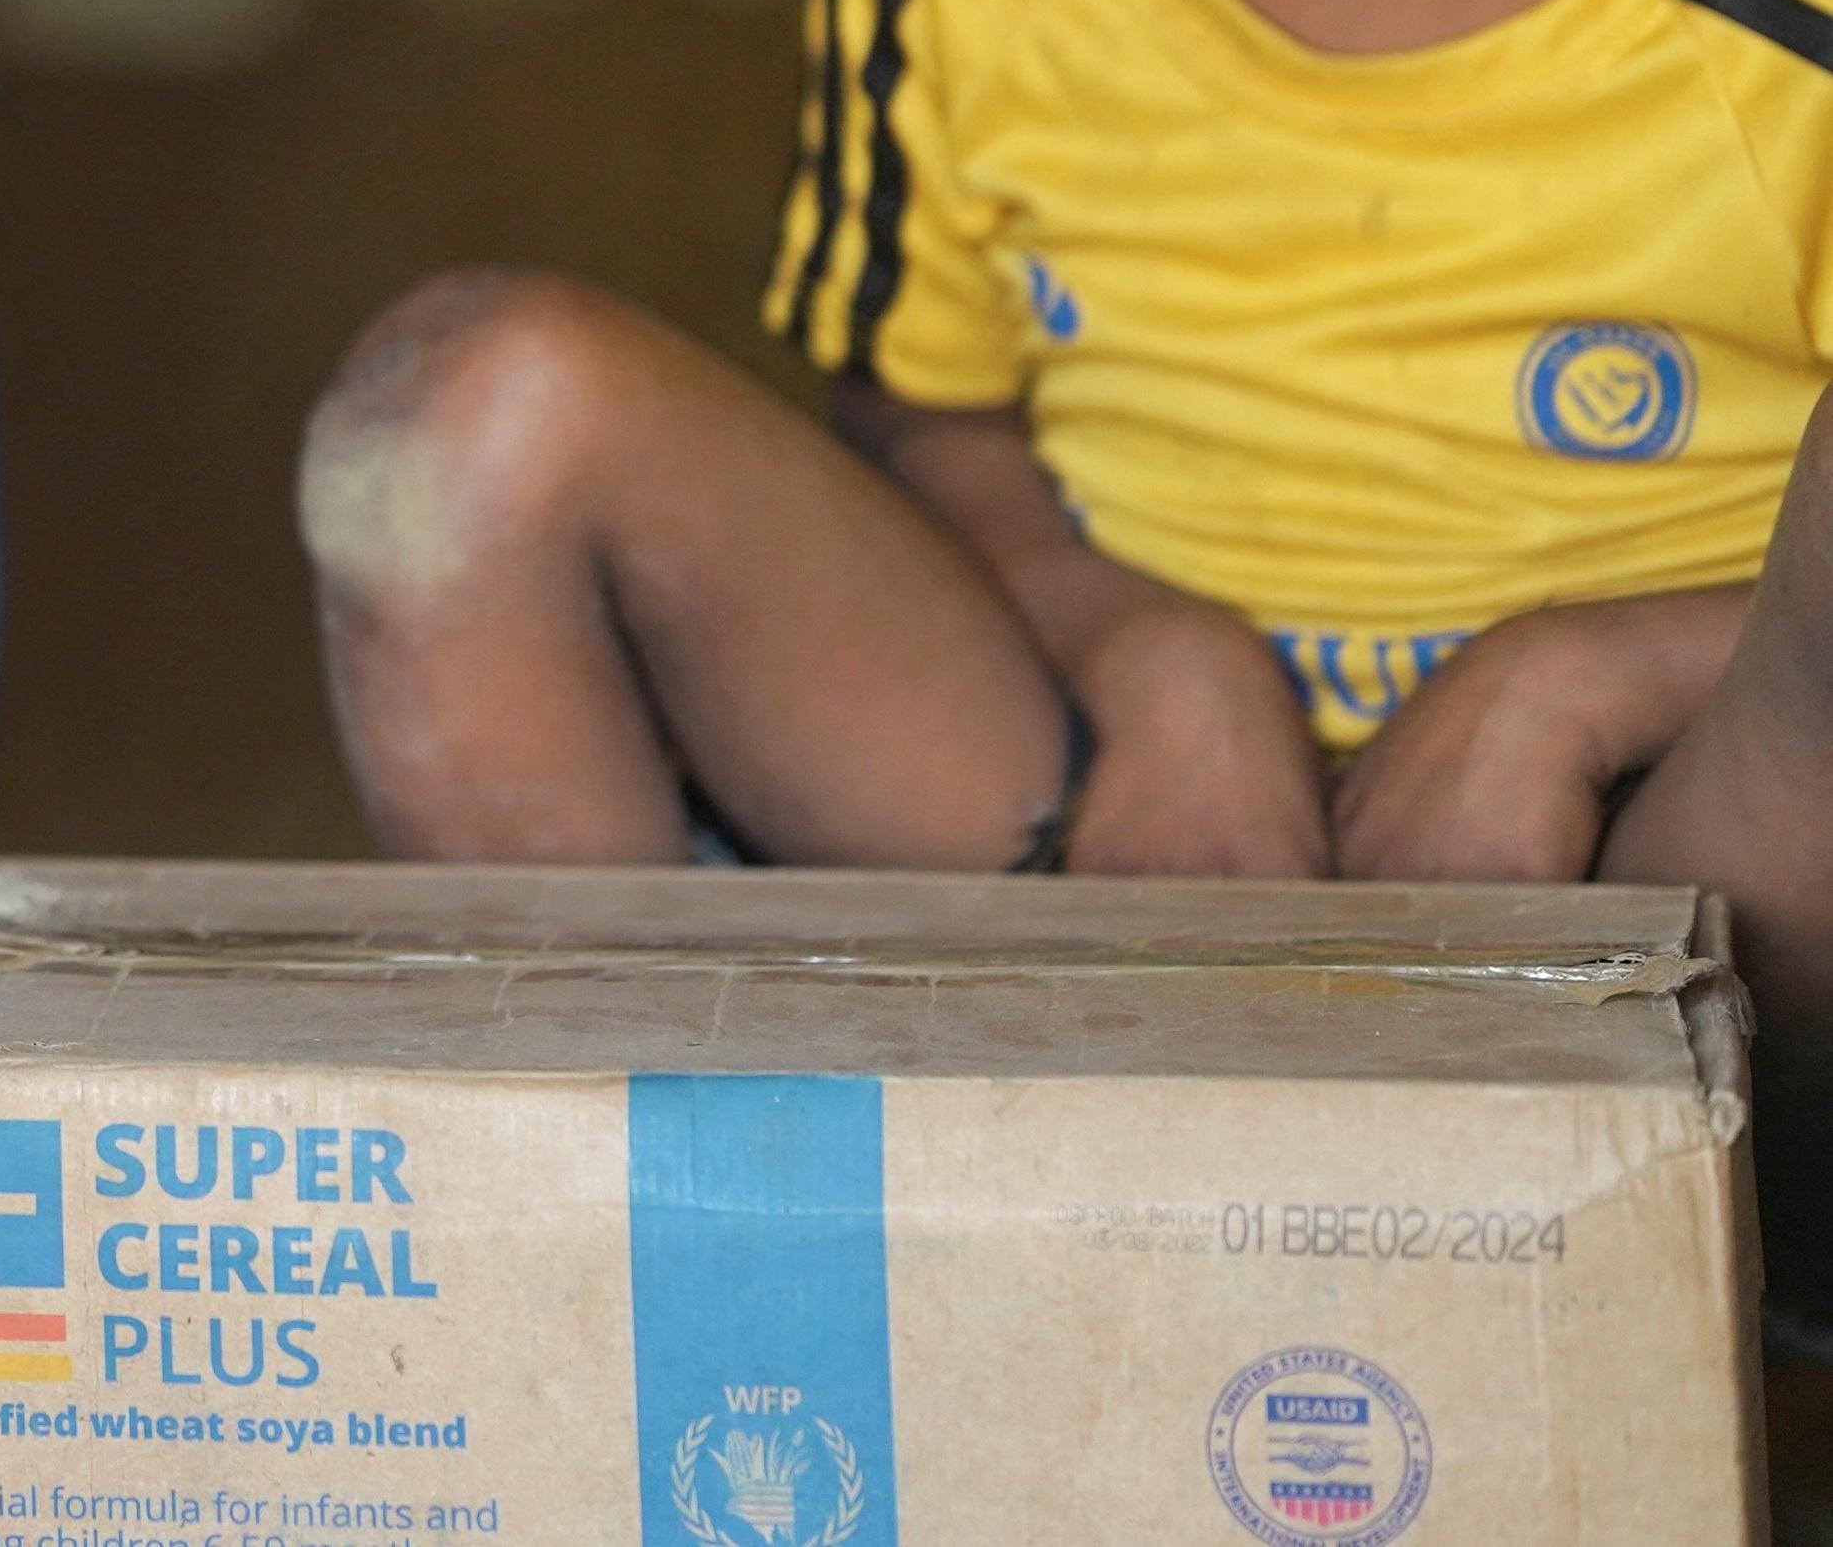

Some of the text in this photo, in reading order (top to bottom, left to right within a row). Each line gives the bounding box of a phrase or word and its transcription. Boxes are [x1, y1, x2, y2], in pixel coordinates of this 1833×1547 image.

[95, 1123, 414, 1205] SUPER
[97, 1221, 438, 1299] CEREAL
[103, 1314, 320, 1388] PLUS
[723, 1384, 803, 1415] WFP
[1221, 1362, 1275, 1417] UNITED
[1279, 1353, 1348, 1373] STATES
[1275, 1399, 1359, 1423] USAID
[90, 1406, 225, 1443] wheat
[237, 1416, 334, 1453] soya
[348, 1412, 467, 1449] blend
[50, 1485, 201, 1523] formula
[213, 1491, 269, 1525] for
[282, 1493, 414, 1531] infants
[427, 1499, 498, 1533] and
